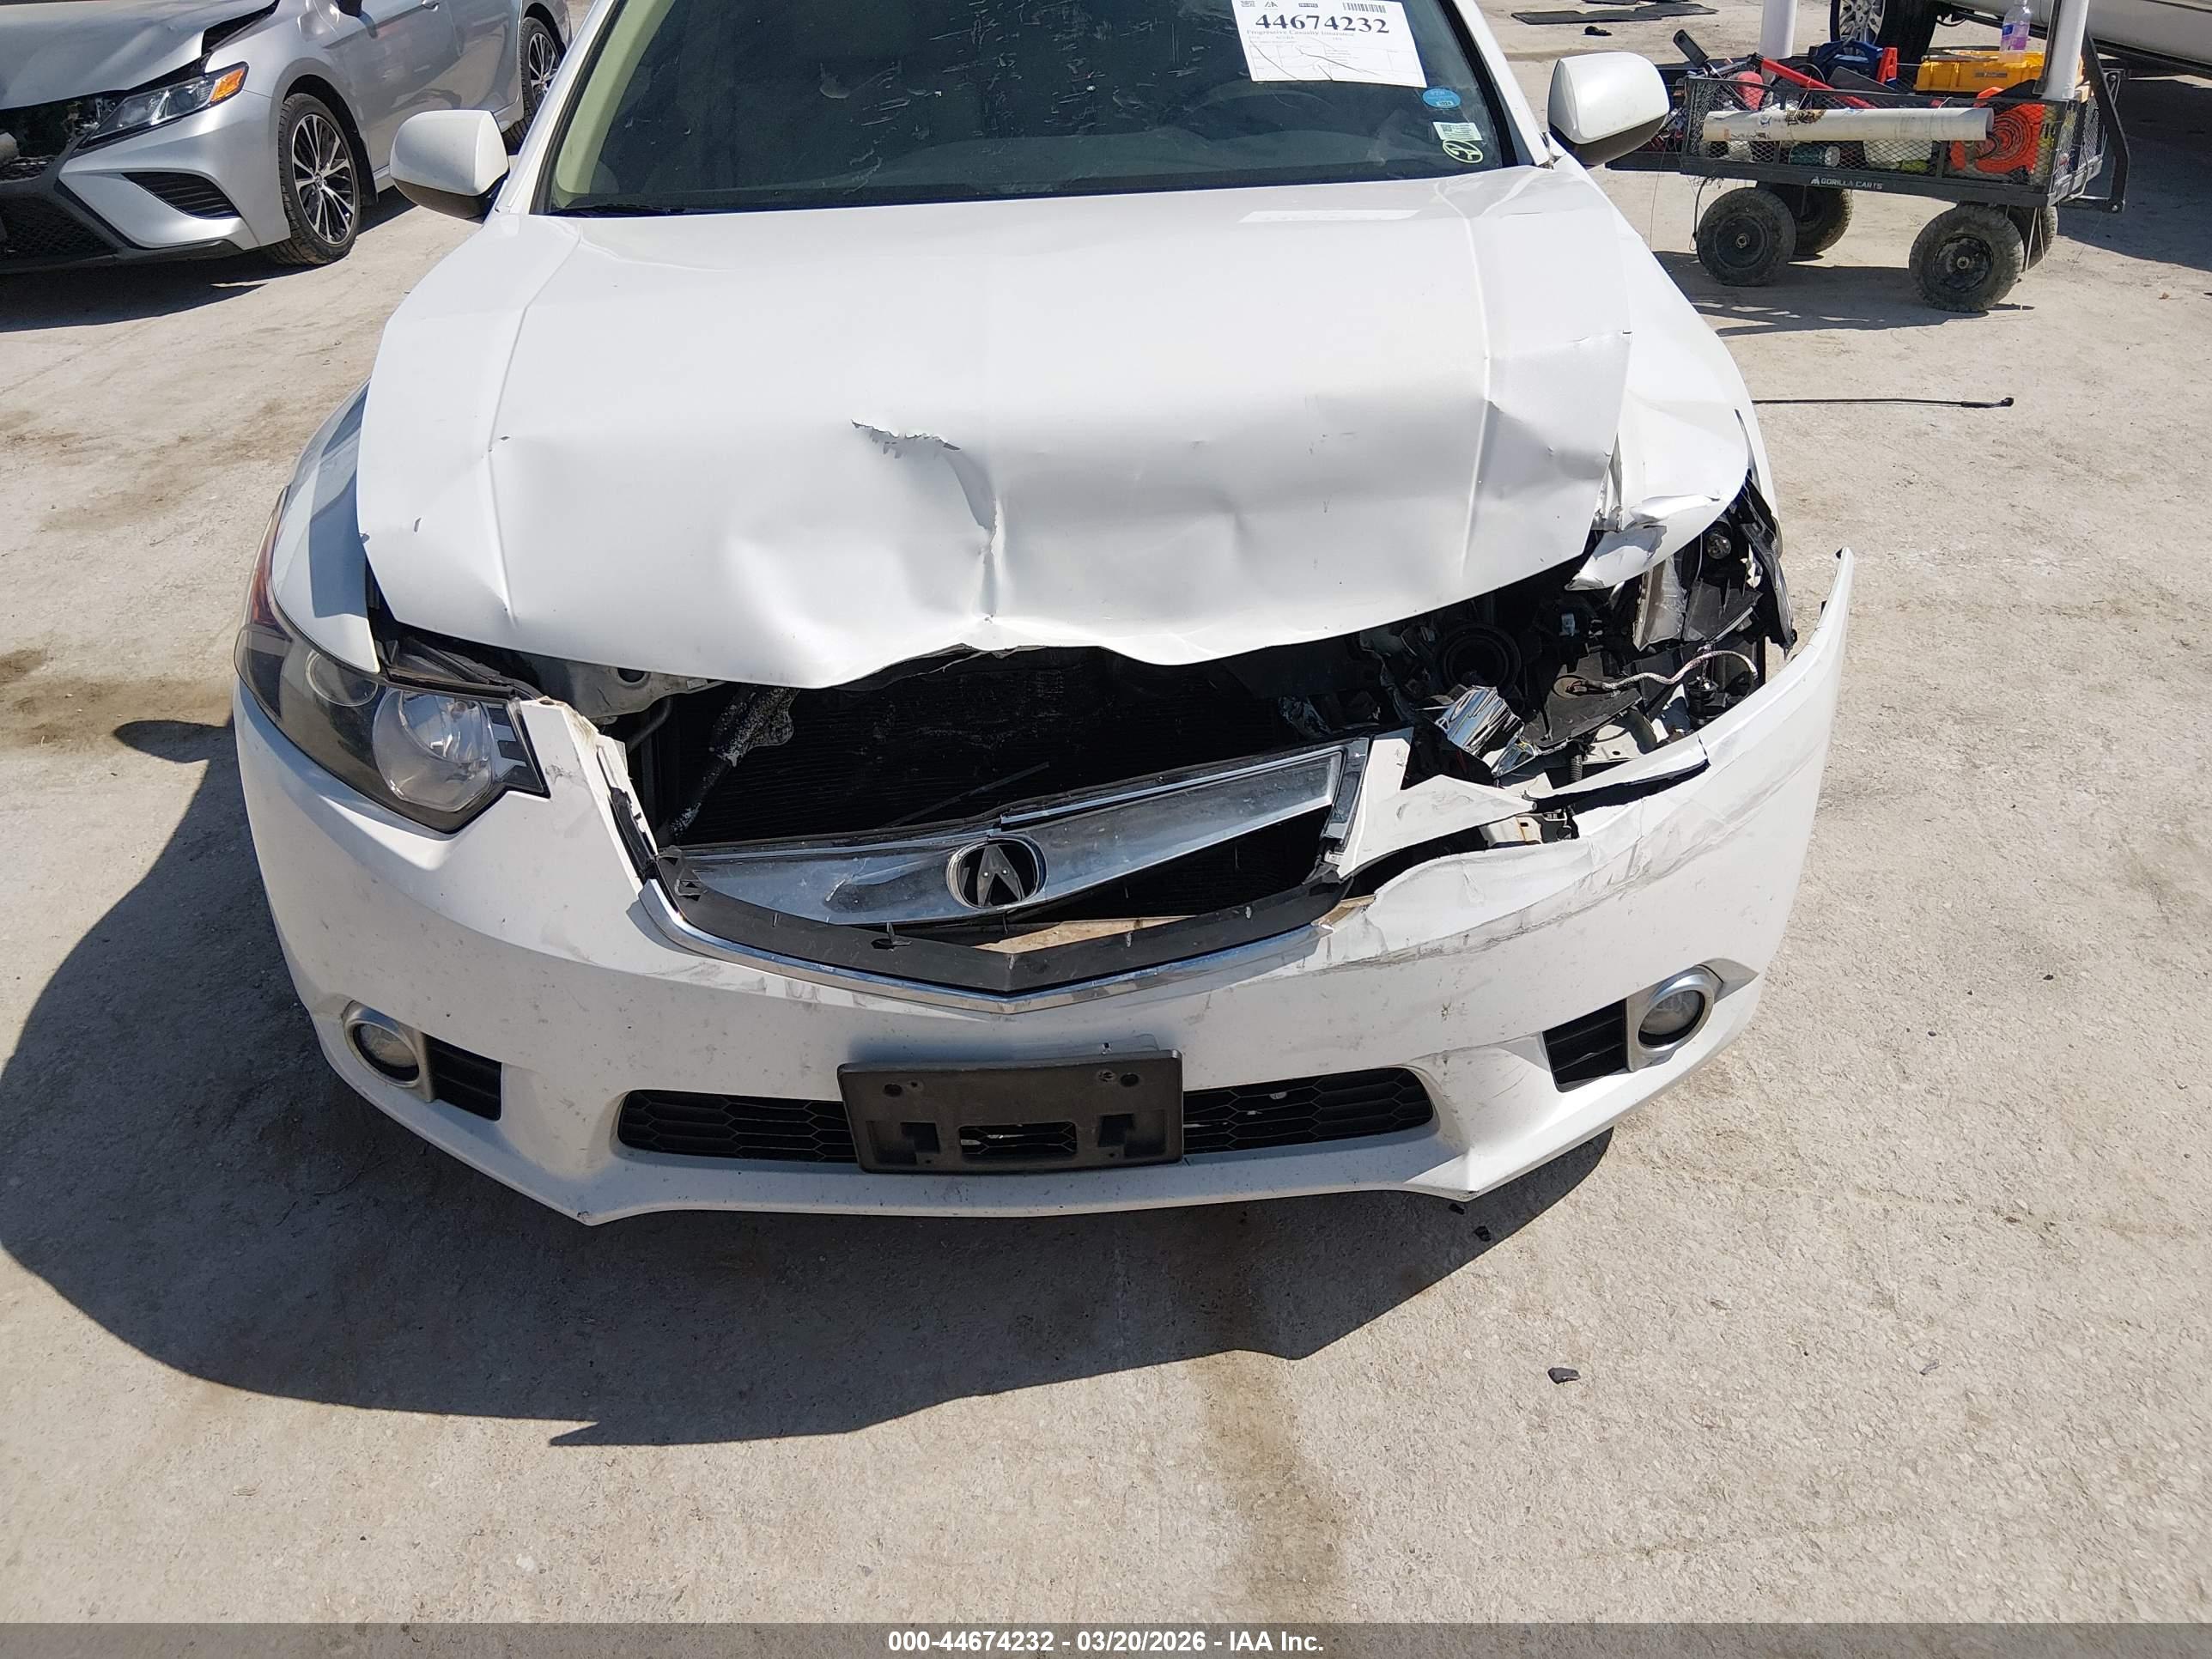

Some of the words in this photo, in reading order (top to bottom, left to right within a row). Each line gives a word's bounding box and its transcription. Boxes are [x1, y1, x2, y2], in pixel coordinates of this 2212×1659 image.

[1255, 14, 1389, 33] 44674232
[1820, 177, 1854, 187] GORILLA
[1856, 180, 1884, 190] CARTS
